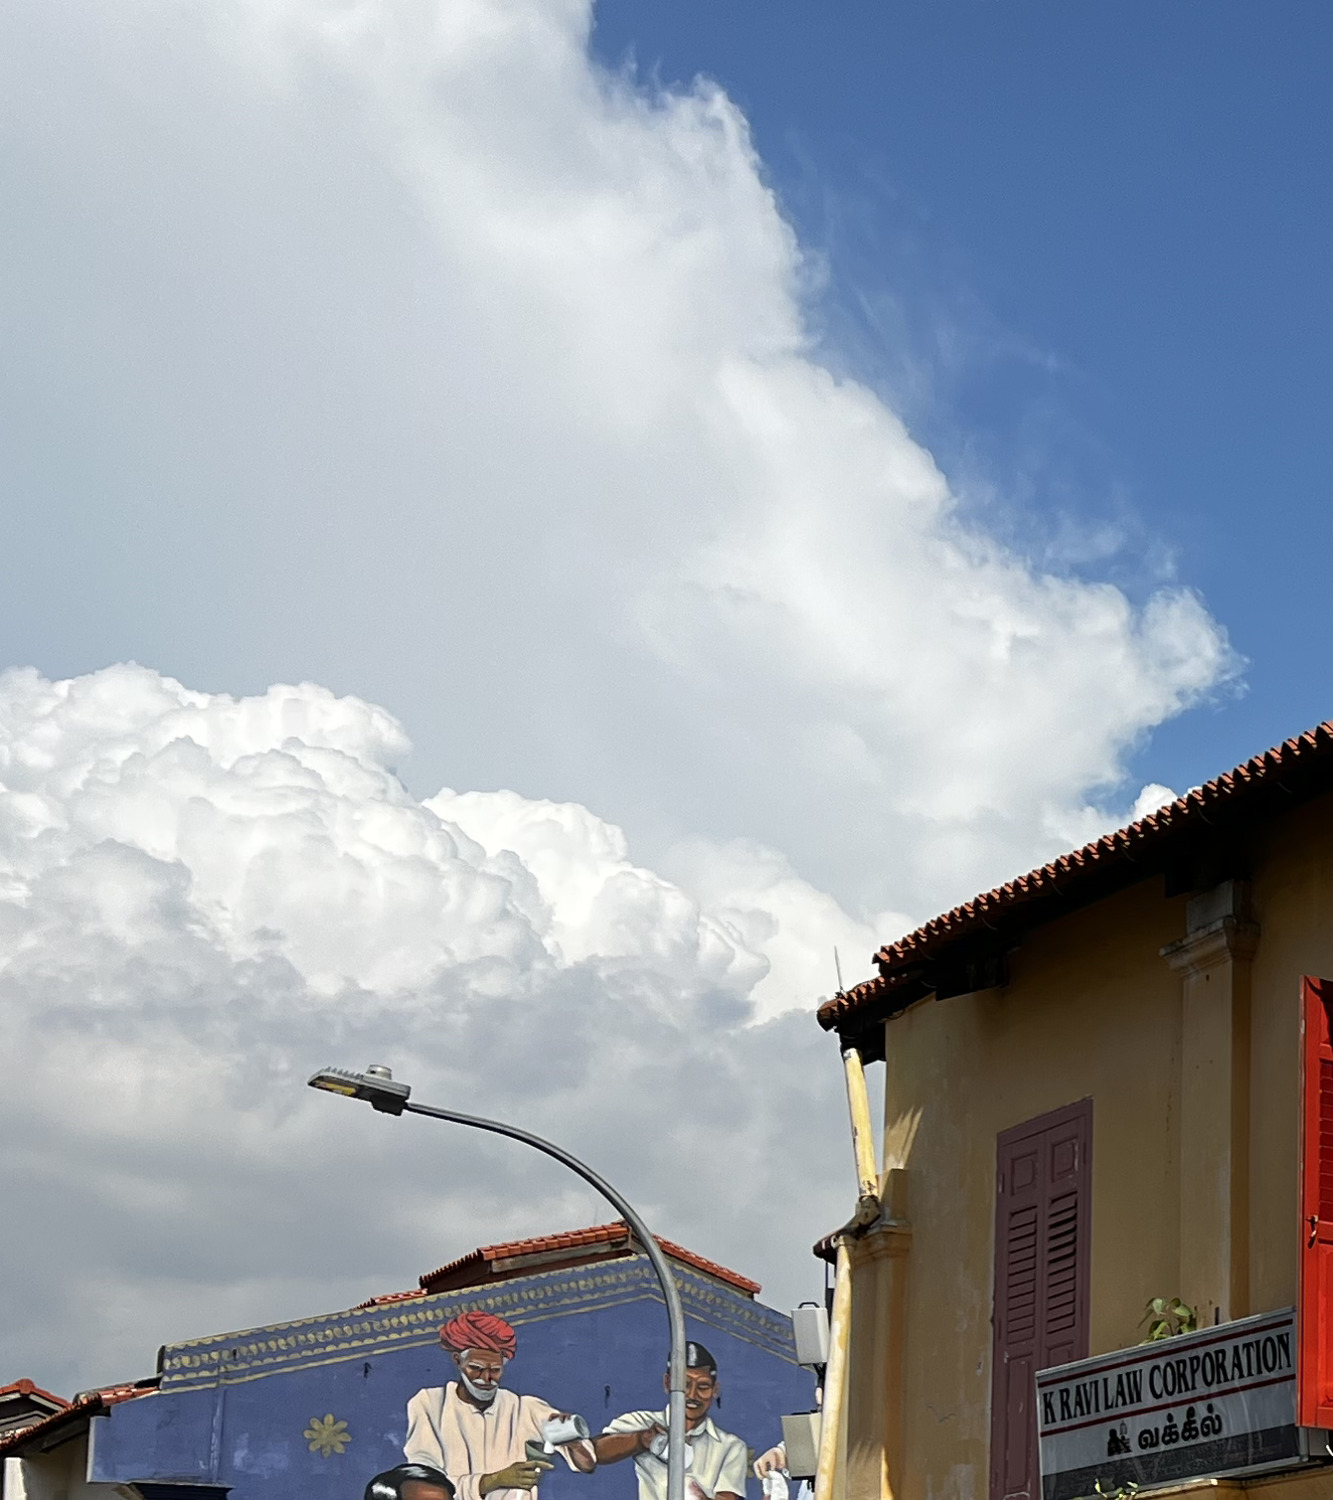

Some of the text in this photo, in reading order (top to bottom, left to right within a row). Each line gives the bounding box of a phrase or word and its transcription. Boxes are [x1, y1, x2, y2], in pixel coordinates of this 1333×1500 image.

[1042, 1332, 1292, 1425] K RAVI LAW CORPORATION
[1138, 1403, 1222, 1450] வக்கீல்
